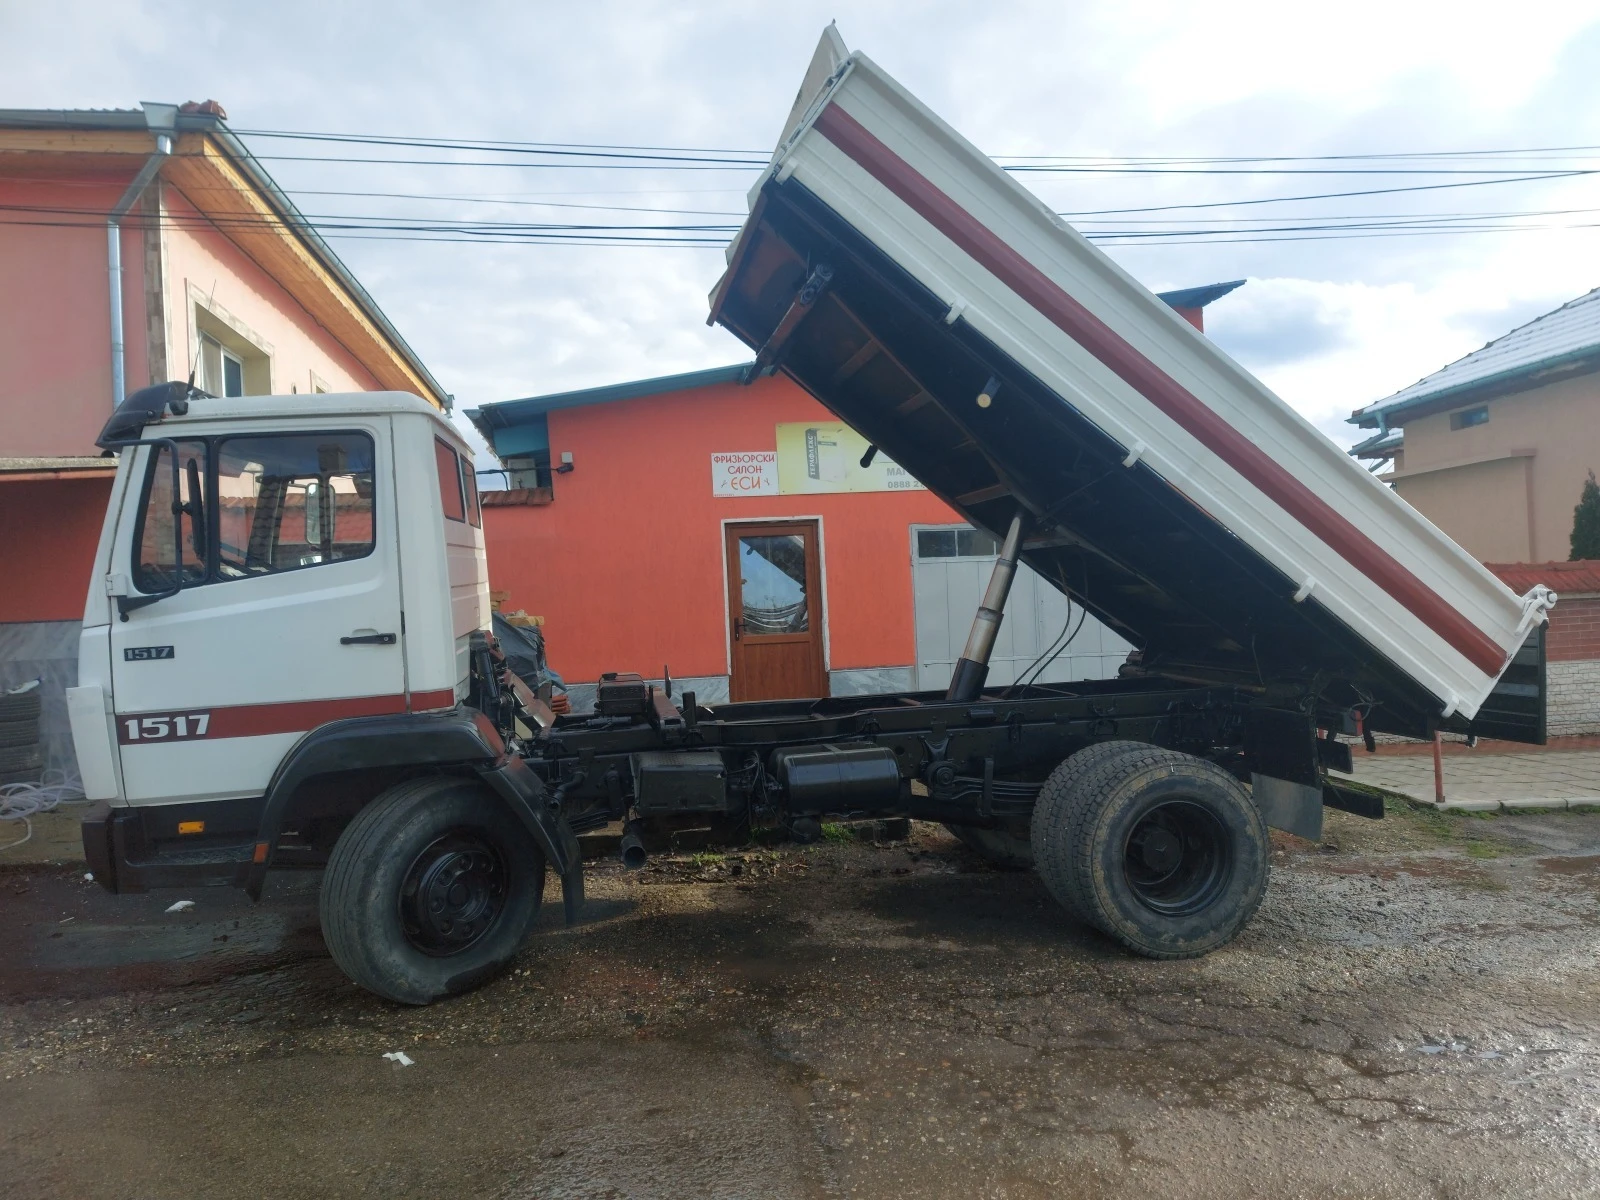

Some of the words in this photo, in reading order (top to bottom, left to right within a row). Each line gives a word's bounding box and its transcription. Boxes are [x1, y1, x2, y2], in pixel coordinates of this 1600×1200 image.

[713, 454, 775, 464] ФРИЗЬОРСКИ
[727, 465, 763, 475] САЛОН
[730, 476, 761, 491] ЕСИ
[887, 481, 911, 489] 0888
[126, 647, 170, 659] 1517
[124, 714, 210, 740] 1517
